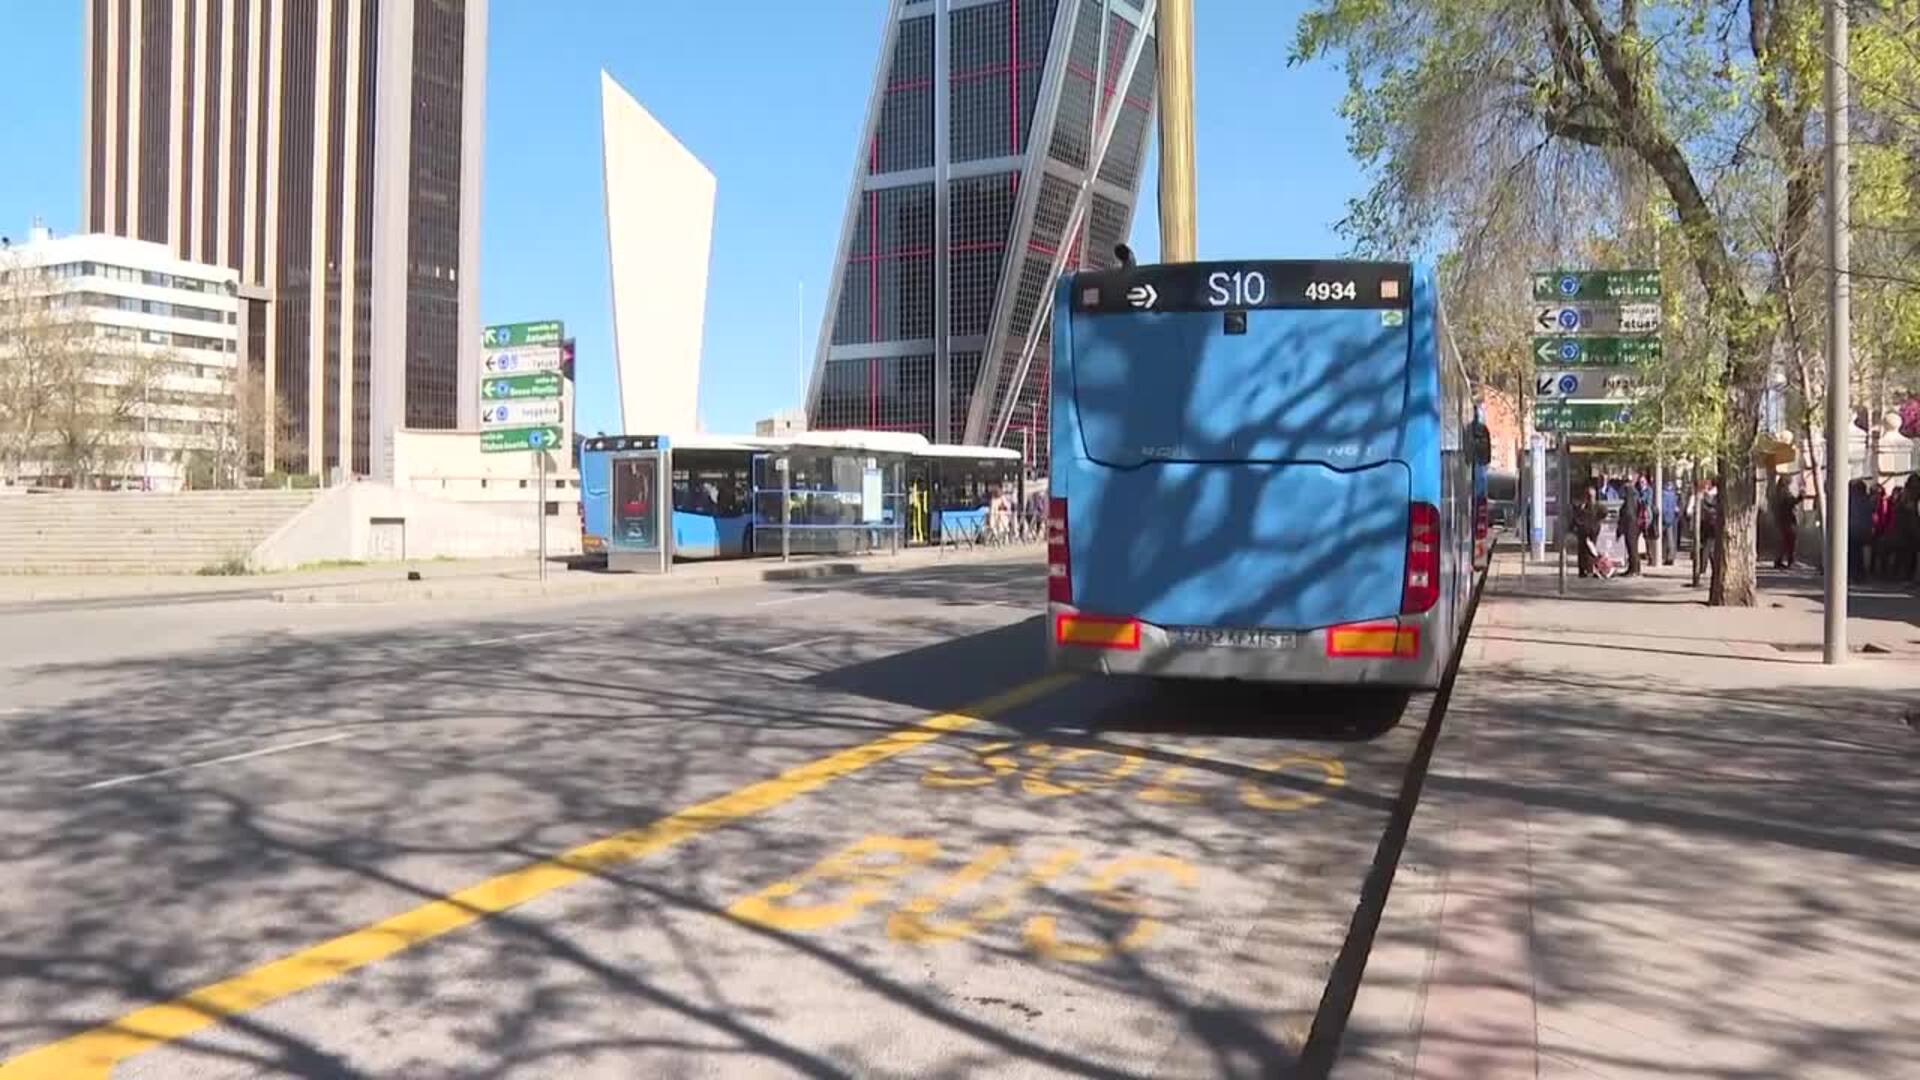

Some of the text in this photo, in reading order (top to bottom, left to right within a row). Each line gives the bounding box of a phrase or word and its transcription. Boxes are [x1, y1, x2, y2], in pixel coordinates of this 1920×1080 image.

[1208, 271, 1266, 306] S10
[1304, 282, 1356, 301] 4934
[728, 834, 1198, 963] BUS
